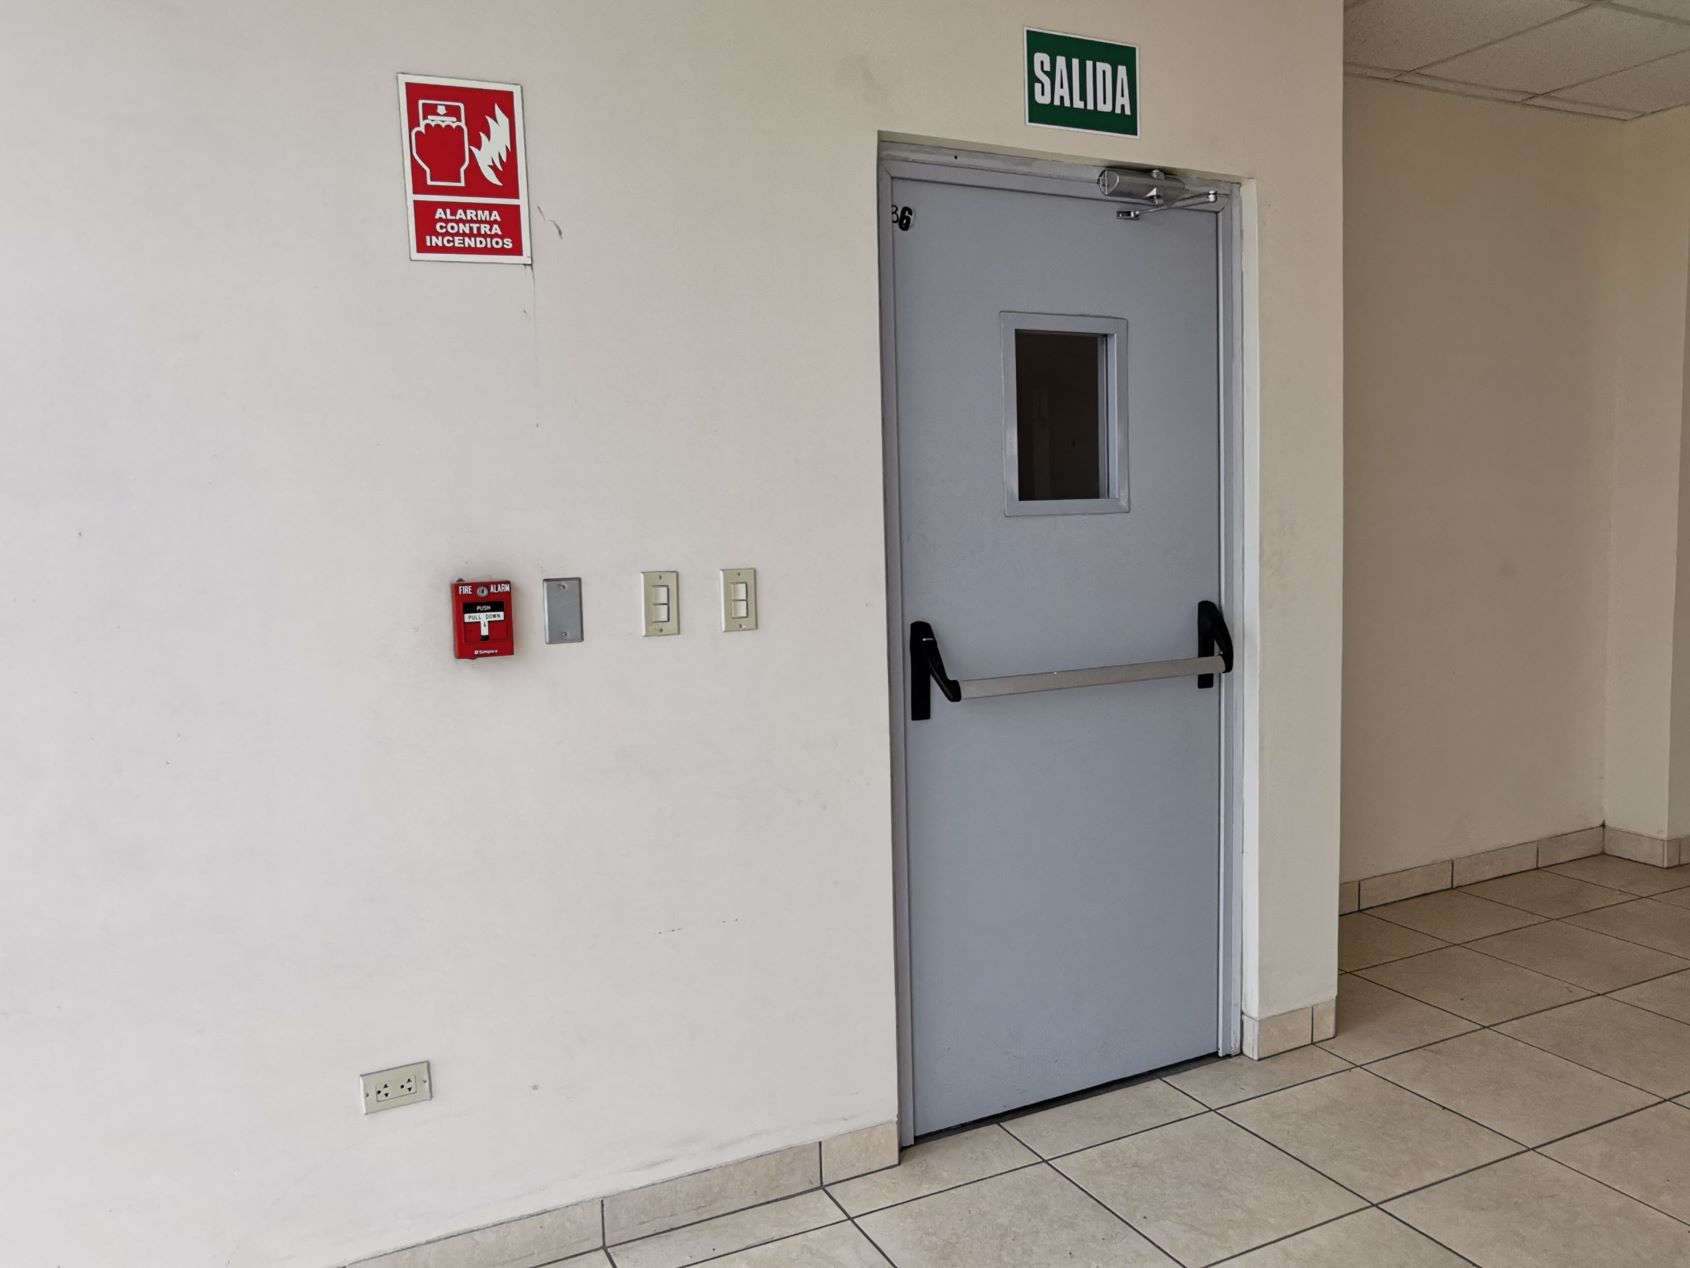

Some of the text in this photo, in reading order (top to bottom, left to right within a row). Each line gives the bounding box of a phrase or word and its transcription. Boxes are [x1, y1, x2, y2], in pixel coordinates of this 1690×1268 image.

[1033, 52, 1131, 115] SALIDA
[434, 208, 501, 221] ALARMA
[435, 222, 502, 235] CONTRA
[425, 235, 513, 249] INCENDIOS
[459, 583, 510, 595] FIRE ALARM
